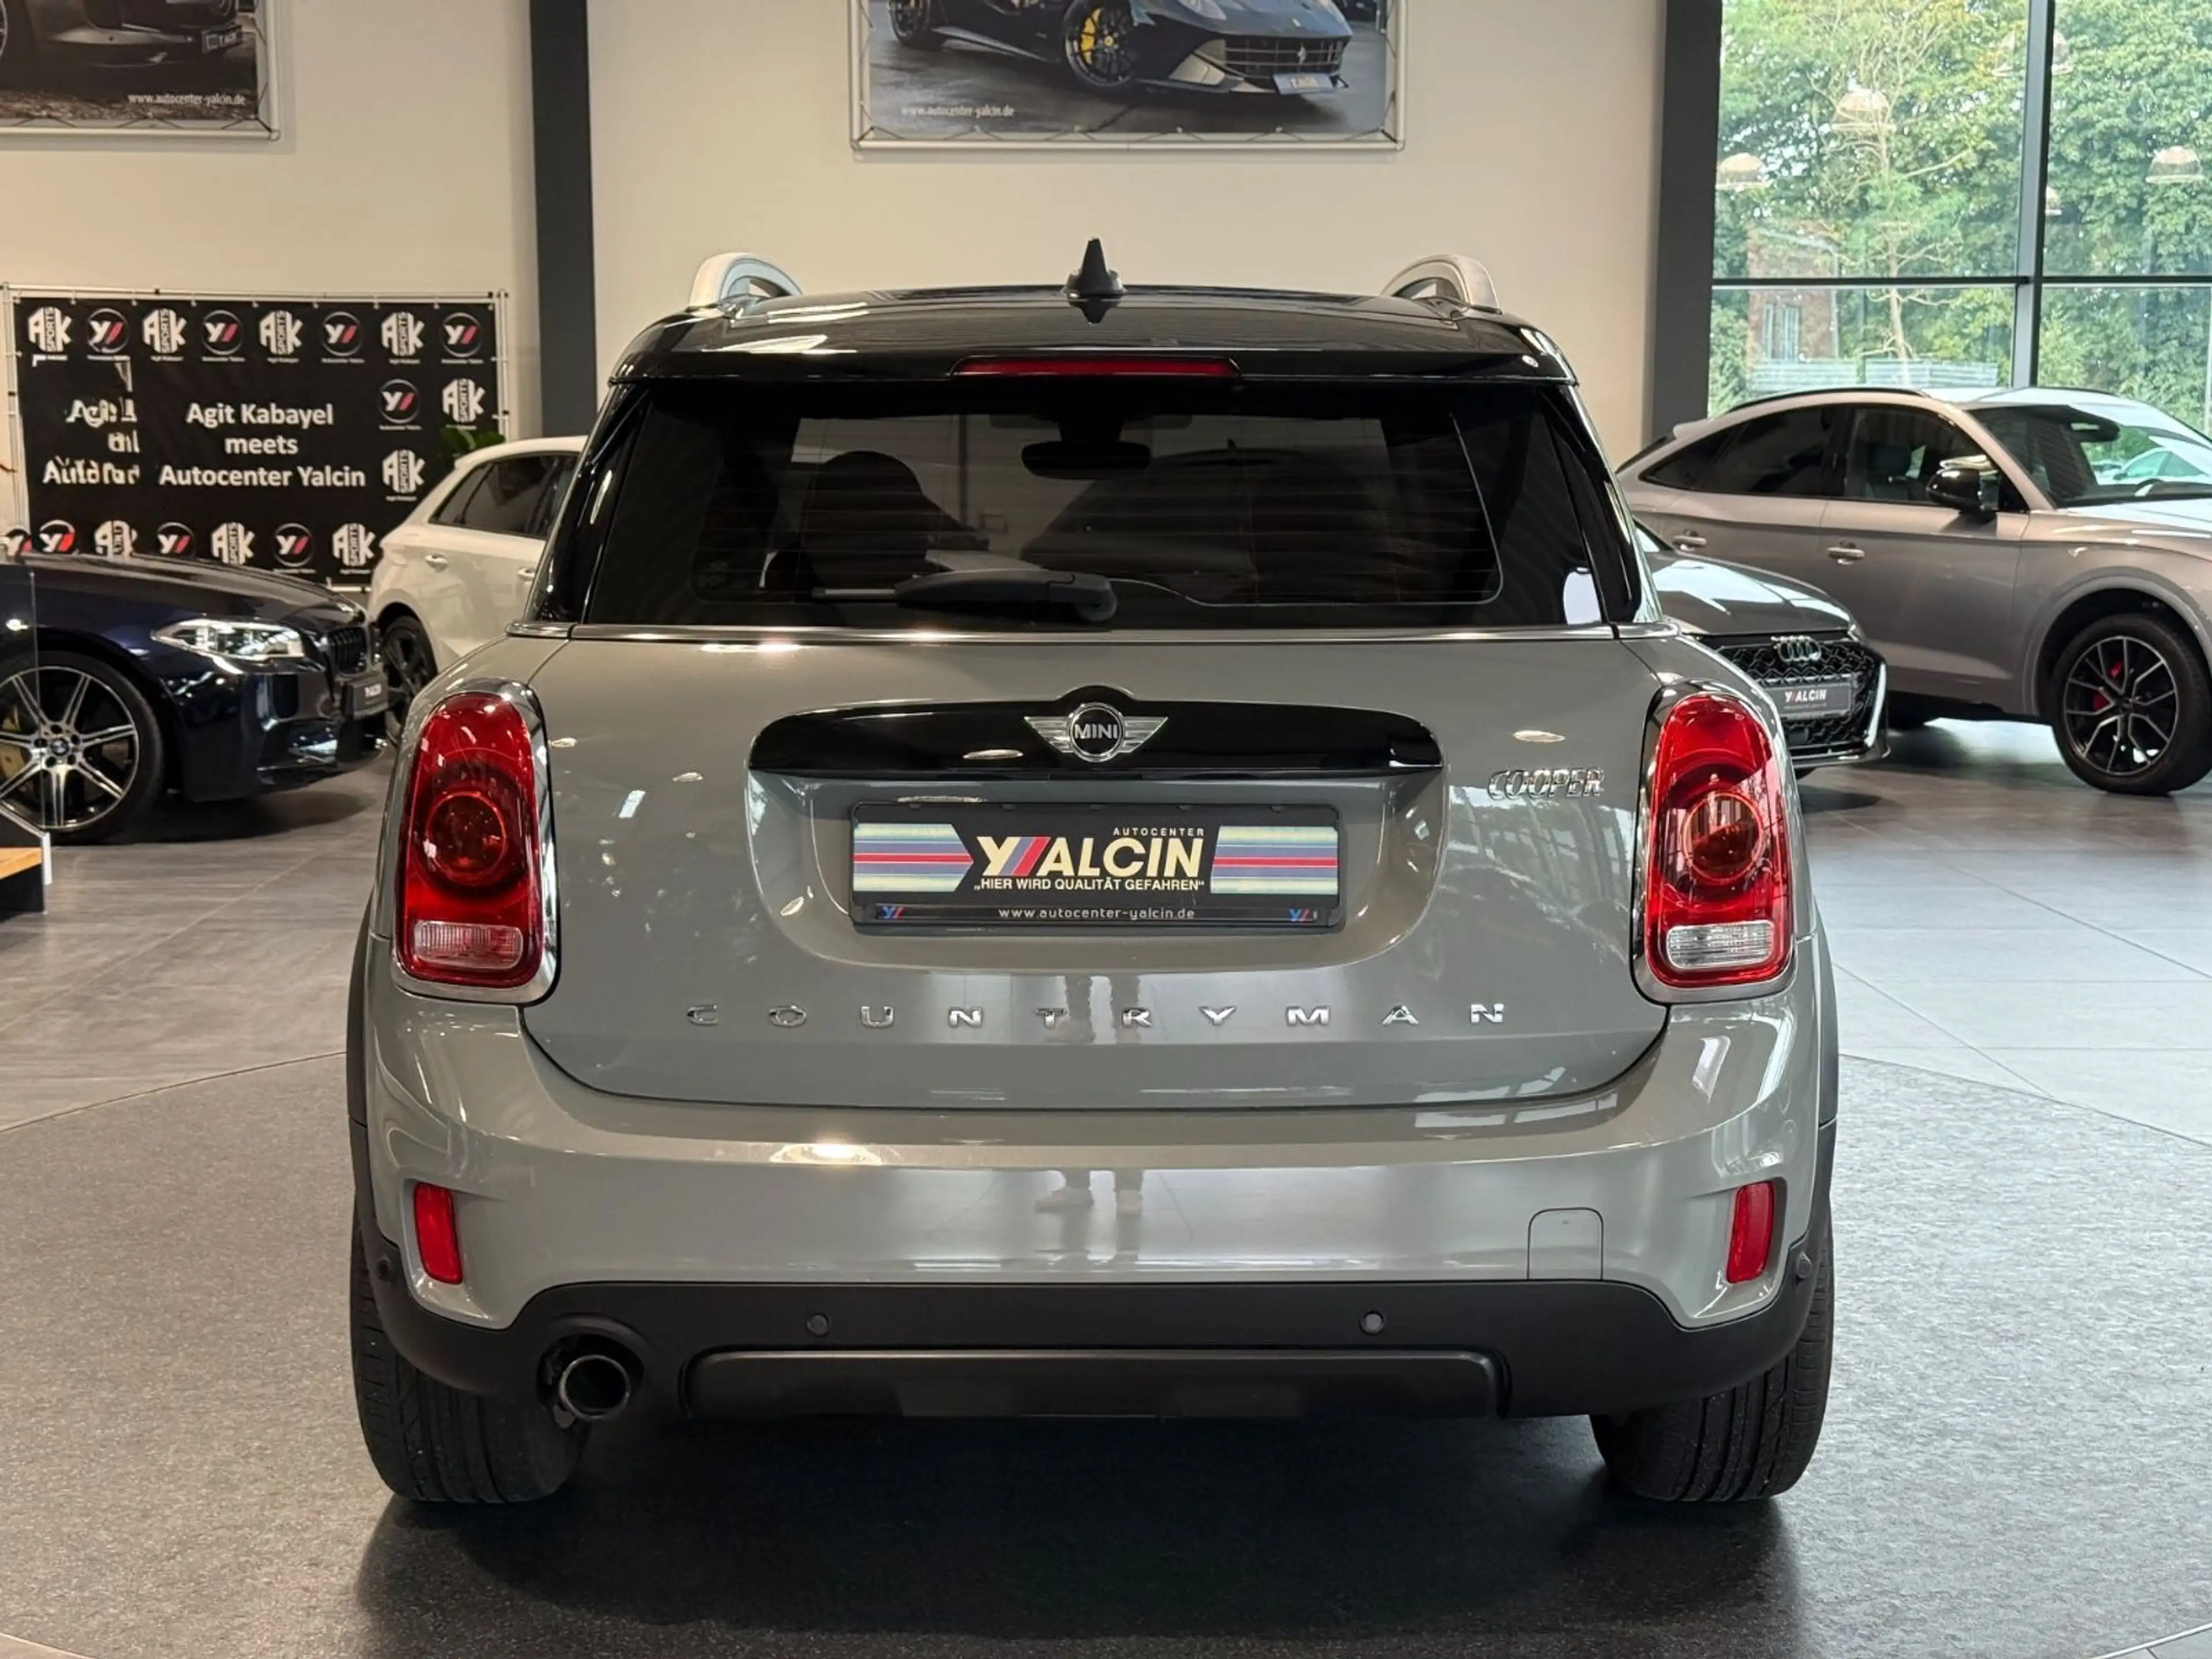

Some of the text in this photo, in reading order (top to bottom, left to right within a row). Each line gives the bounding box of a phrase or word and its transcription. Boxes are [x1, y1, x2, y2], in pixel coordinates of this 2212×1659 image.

[186, 403, 334, 429] Agit Kabayel
[224, 435, 299, 454] meets
[158, 464, 366, 487] Autocenter Yalcin
[1074, 724, 1118, 739] MINI
[1487, 767, 1604, 800] COOPER
[1113, 827, 1205, 836] AUTOCENTER
[1016, 879, 1051, 891] WIRD
[1055, 876, 1121, 891] QUALITÄT
[998, 908, 1195, 920] www.autocenter-yalcin.de
[687, 1003, 1505, 1028] COUNTRYMAN
